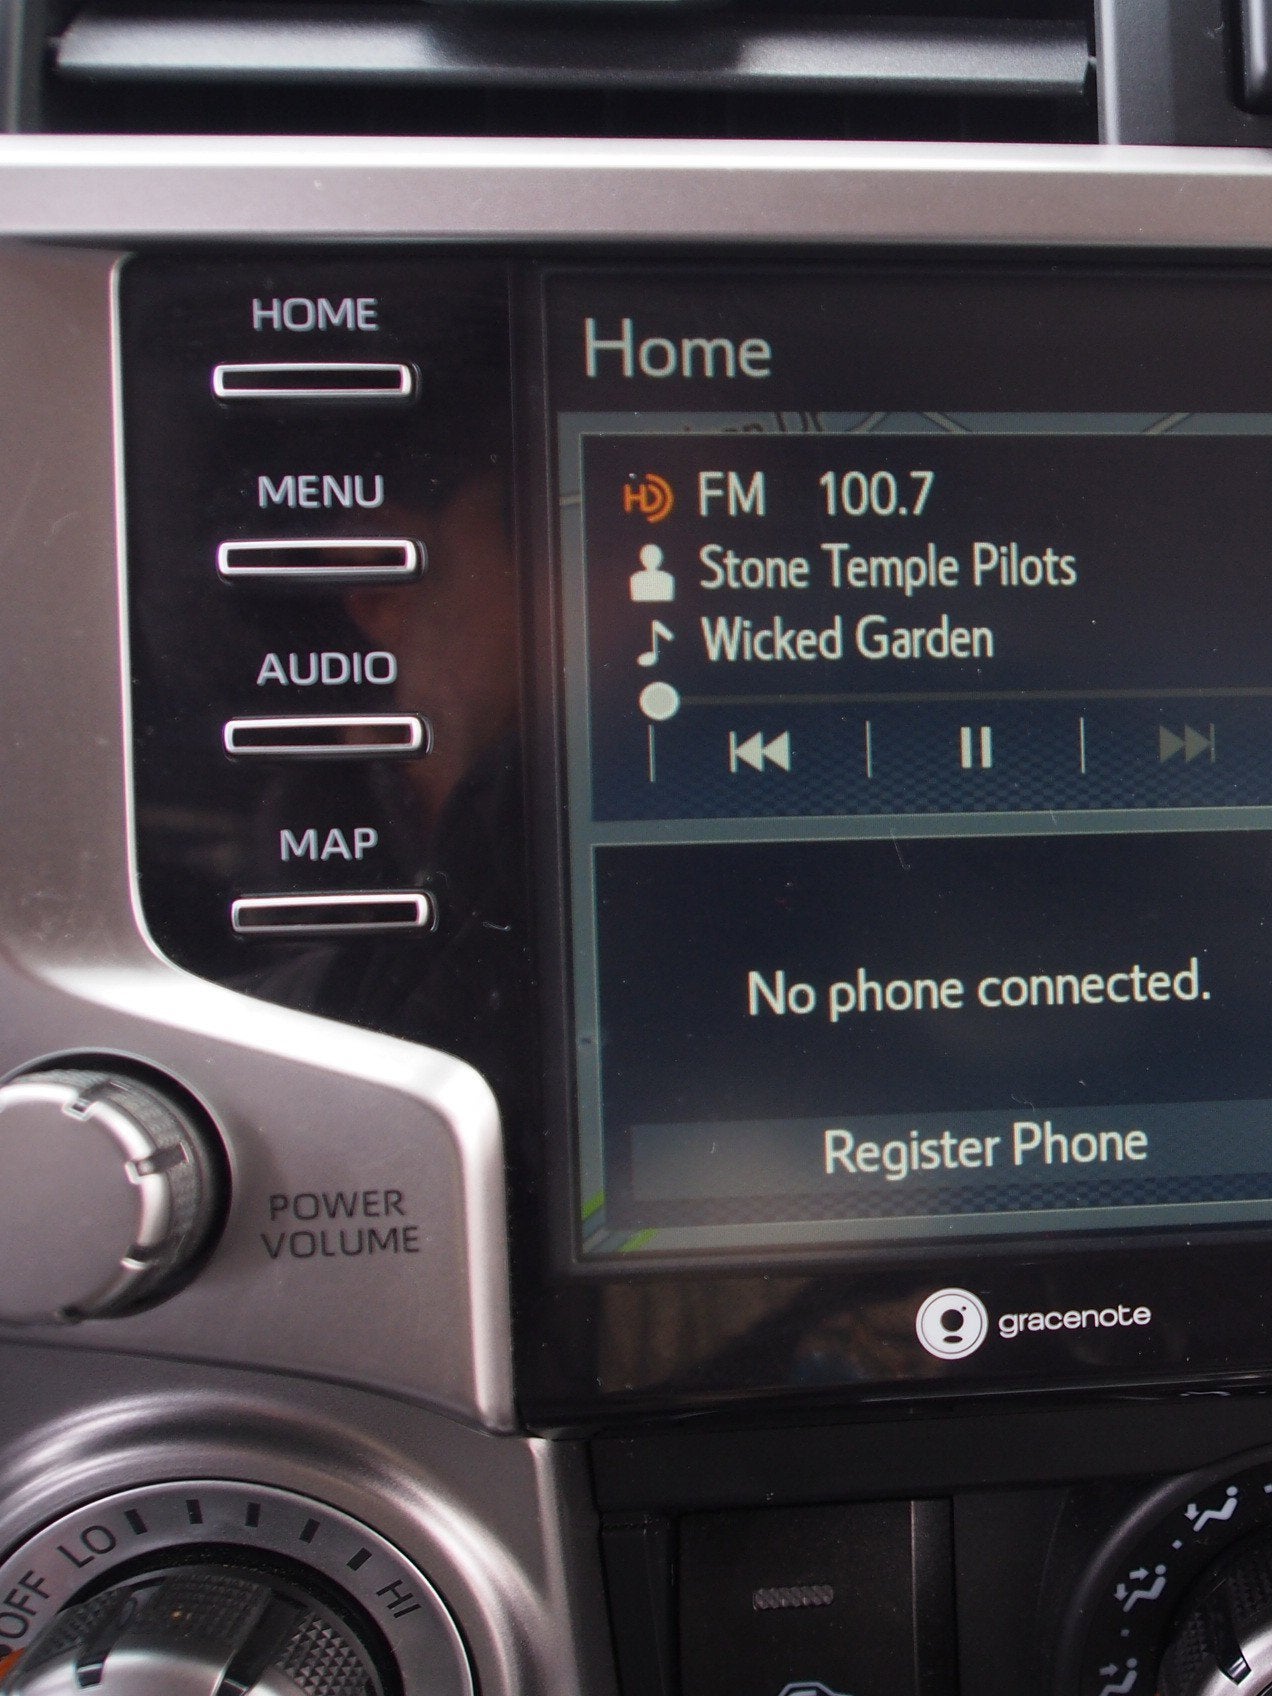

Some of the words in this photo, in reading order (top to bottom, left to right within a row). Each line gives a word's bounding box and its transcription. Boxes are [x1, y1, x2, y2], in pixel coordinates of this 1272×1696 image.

[252, 297, 380, 332] HOME
[583, 317, 773, 380] Home
[257, 474, 386, 511] MENU
[699, 470, 766, 517] FM
[819, 470, 936, 517] 100.7
[700, 543, 810, 590] Stone
[820, 542, 960, 597] Temple
[973, 541, 1078, 588] Pilots
[701, 615, 843, 664] Wicked
[855, 613, 995, 661] Garden
[256, 651, 398, 686] AUDIO
[279, 827, 379, 862] MAP
[747, 970, 817, 1017] No
[829, 967, 965, 1023] phone
[976, 956, 1212, 1009] connected.
[824, 1129, 1002, 1181] Register
[1012, 1120, 1149, 1166] Phone
[268, 1189, 407, 1221] POWER
[260, 1226, 421, 1260] VOLUME
[998, 1304, 1152, 1338] gracenote
[57, 1525, 116, 1568] LO
[0, 1569, 50, 1639] OFF
[376, 1579, 421, 1618] HI
